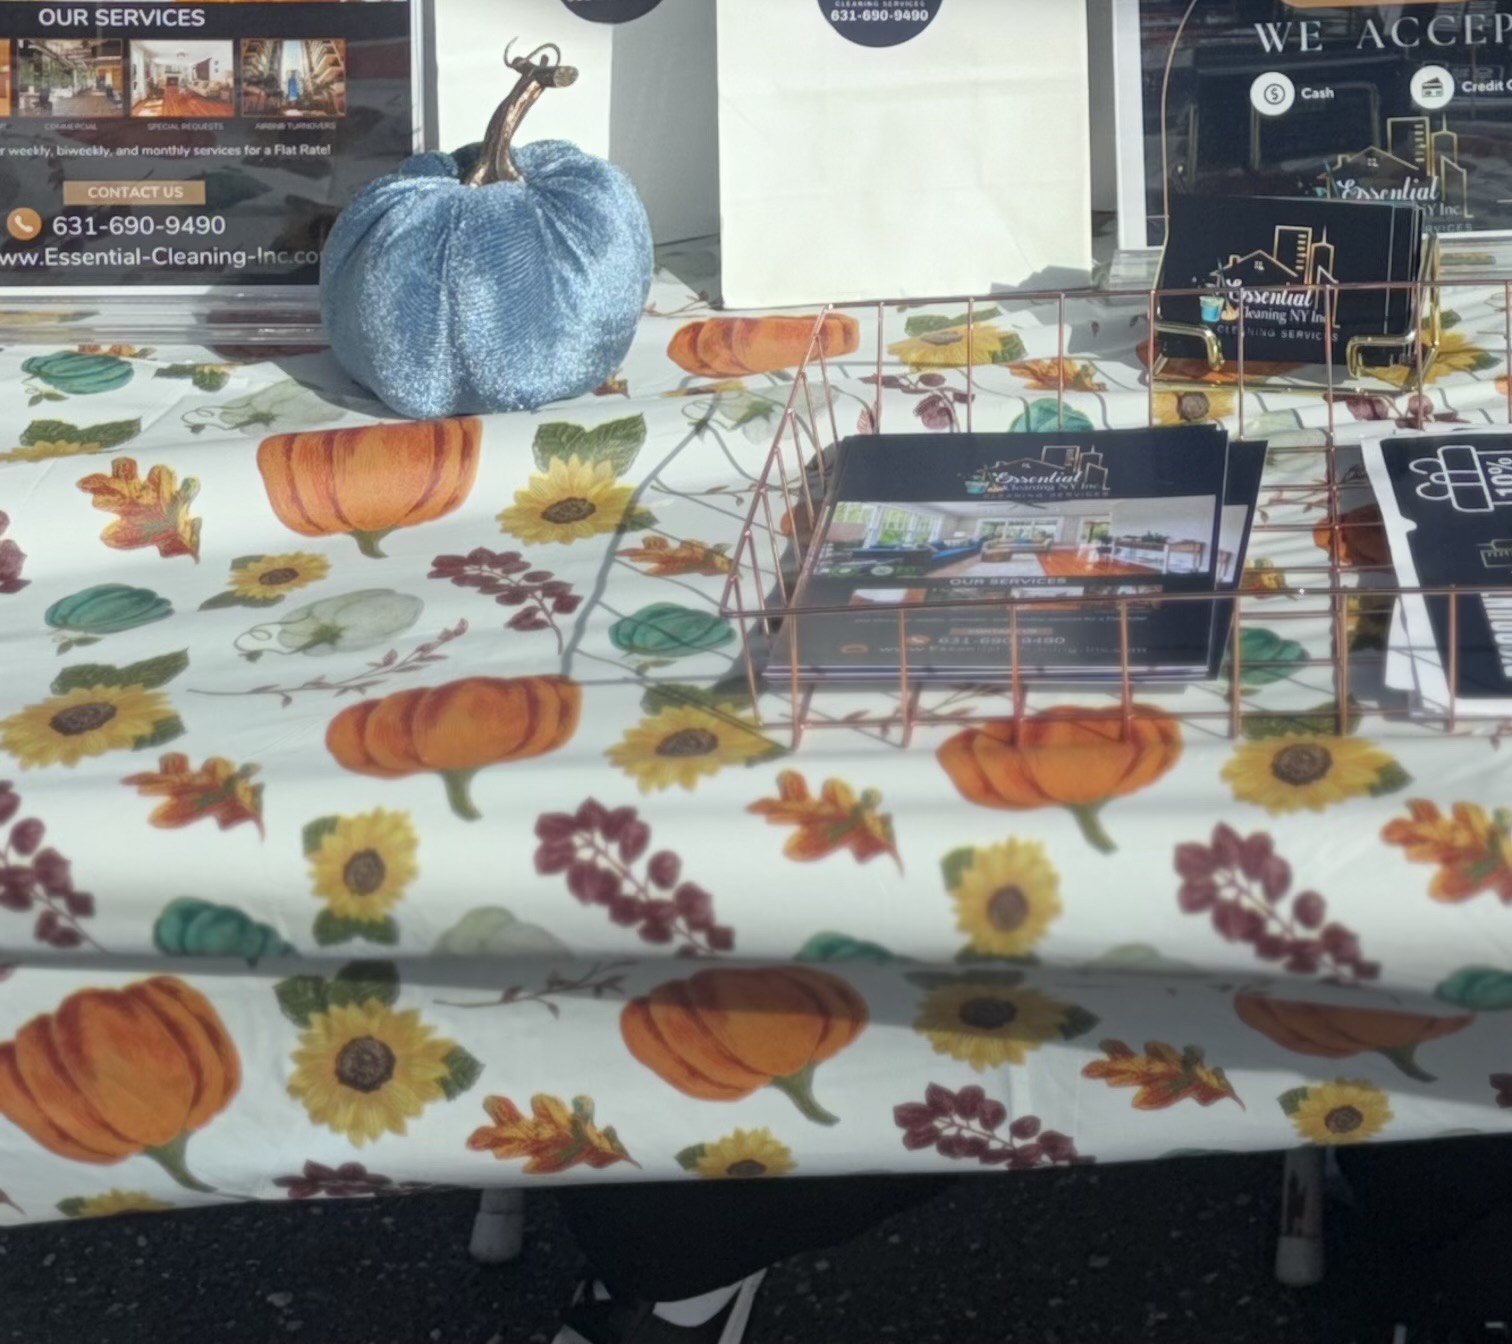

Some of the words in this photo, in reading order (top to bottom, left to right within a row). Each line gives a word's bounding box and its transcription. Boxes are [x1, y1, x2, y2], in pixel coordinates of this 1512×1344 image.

[38, 8, 88, 26] OUR
[95, 8, 205, 26] SERVICES
[831, 9, 929, 22] 631-690-9490
[1254, 20, 1323, 53] WE
[1301, 87, 1334, 99] Cash
[1461, 80, 1503, 93] Credit
[8, 145, 54, 157] weekly,
[56, 145, 113, 157] biweekly,
[116, 145, 138, 156] and
[141, 144, 190, 157] monthly
[194, 145, 241, 155] services
[244, 144, 261, 155] for
[264, 146, 271, 155] a
[274, 144, 296, 155] Flat
[300, 144, 331, 155] Rate!
[88, 186, 159, 199] CONTACT
[163, 186, 184, 199] US
[52, 215, 226, 235] 631-690-9490
[1243, 306, 1287, 325] leaning
[1289, 308, 1309, 323] NY
[1217, 324, 1276, 337] CLENING
[1281, 330, 1338, 342] SERVICS
[950, 577, 987, 586] OUR
[990, 577, 1067, 585] SERVICES
